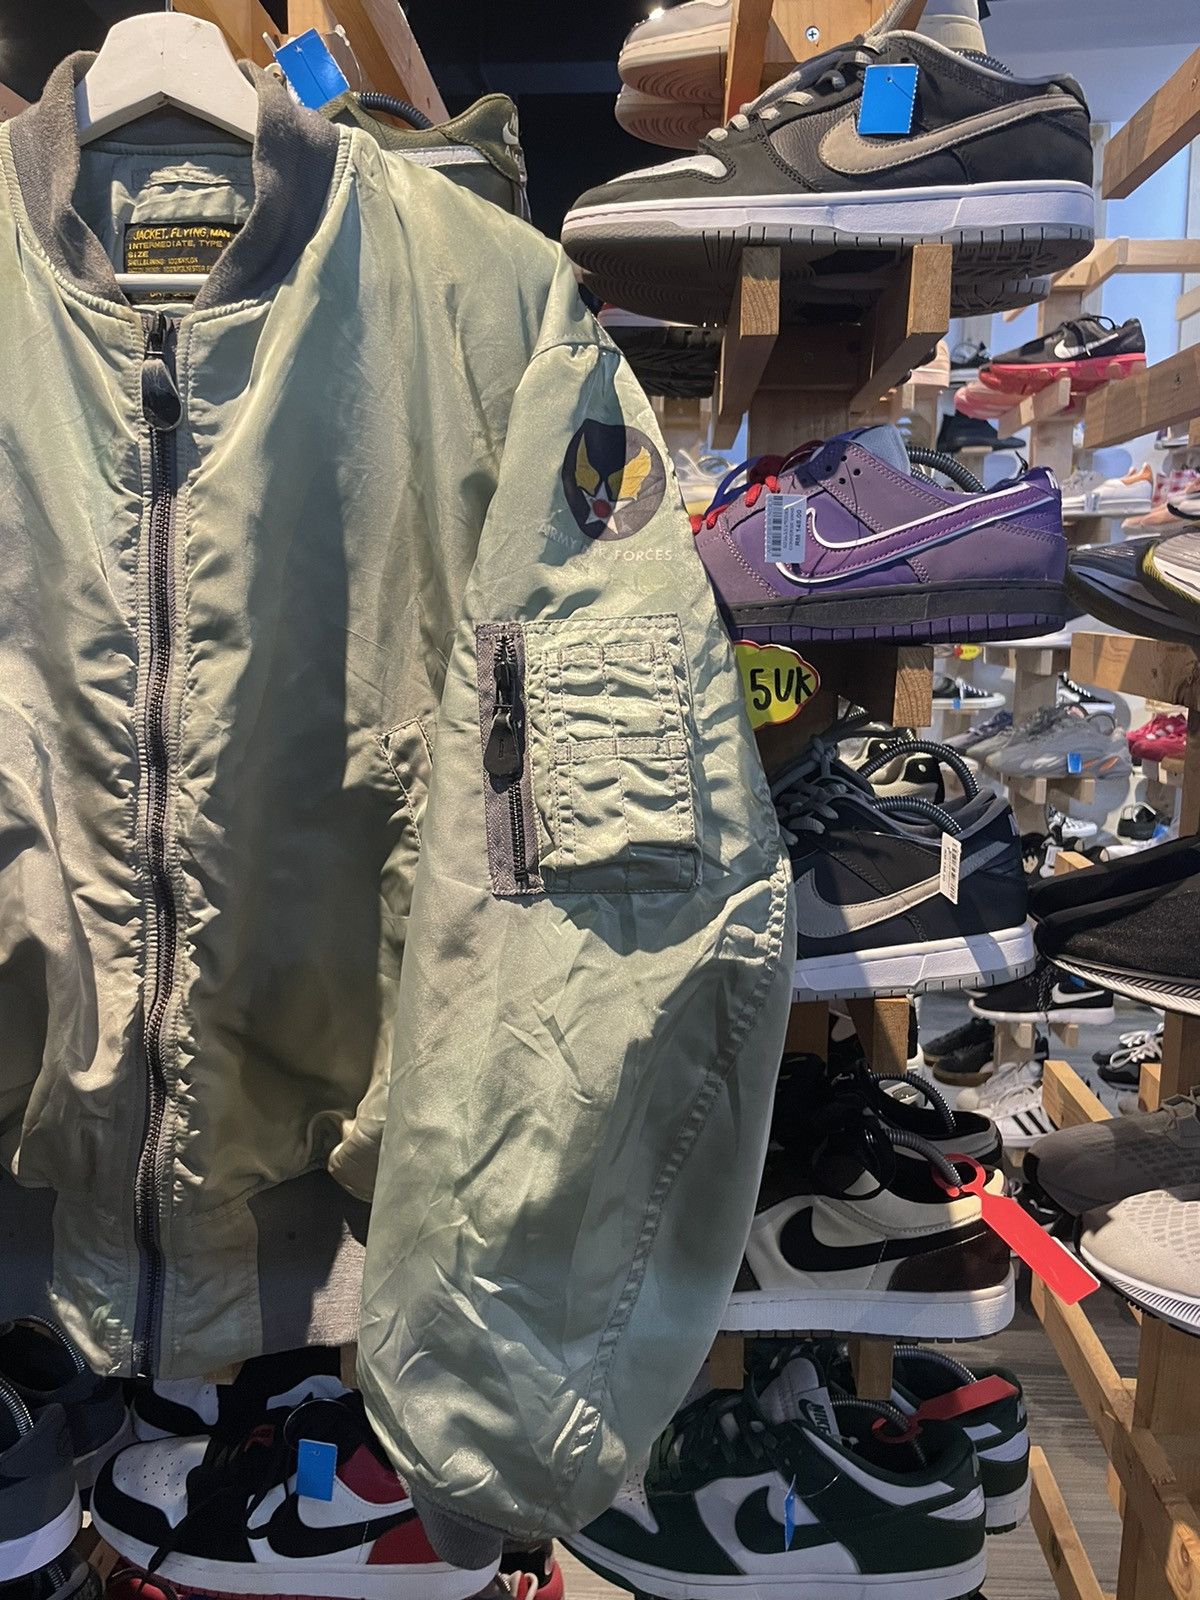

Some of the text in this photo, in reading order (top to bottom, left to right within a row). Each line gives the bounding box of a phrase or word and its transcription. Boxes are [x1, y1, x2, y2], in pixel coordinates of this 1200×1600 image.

[209, 229, 231, 238] MAN
[200, 240, 223, 248] TYPE
[127, 250, 149, 258] SIZE
[614, 549, 673, 561] FORCES
